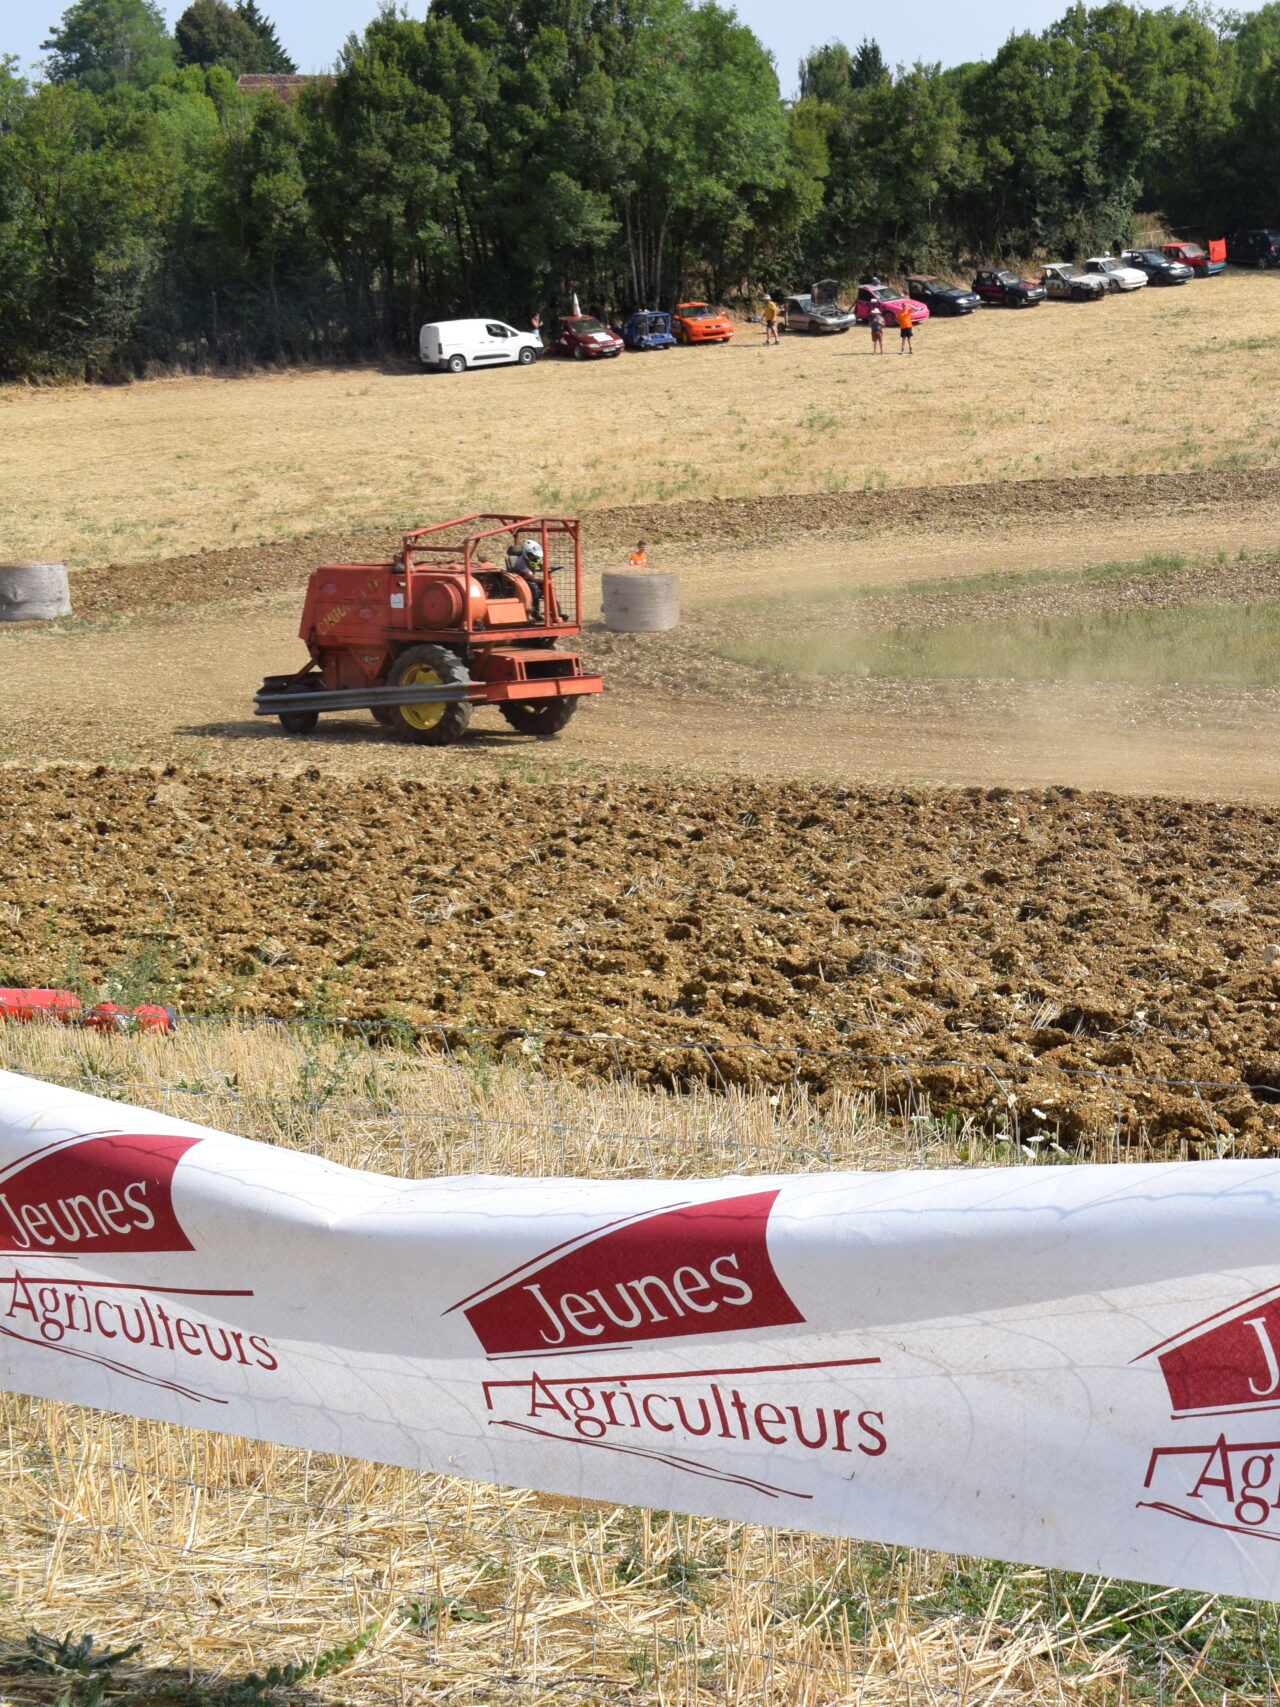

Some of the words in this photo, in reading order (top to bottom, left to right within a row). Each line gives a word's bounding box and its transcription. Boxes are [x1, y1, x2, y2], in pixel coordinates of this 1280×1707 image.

[0, 1180, 155, 1249] Jeunes
[5, 1268, 278, 1371] Agriculteurs
[522, 1253, 753, 1344] Jeunes
[526, 1371, 888, 1456] Agriculteurs
